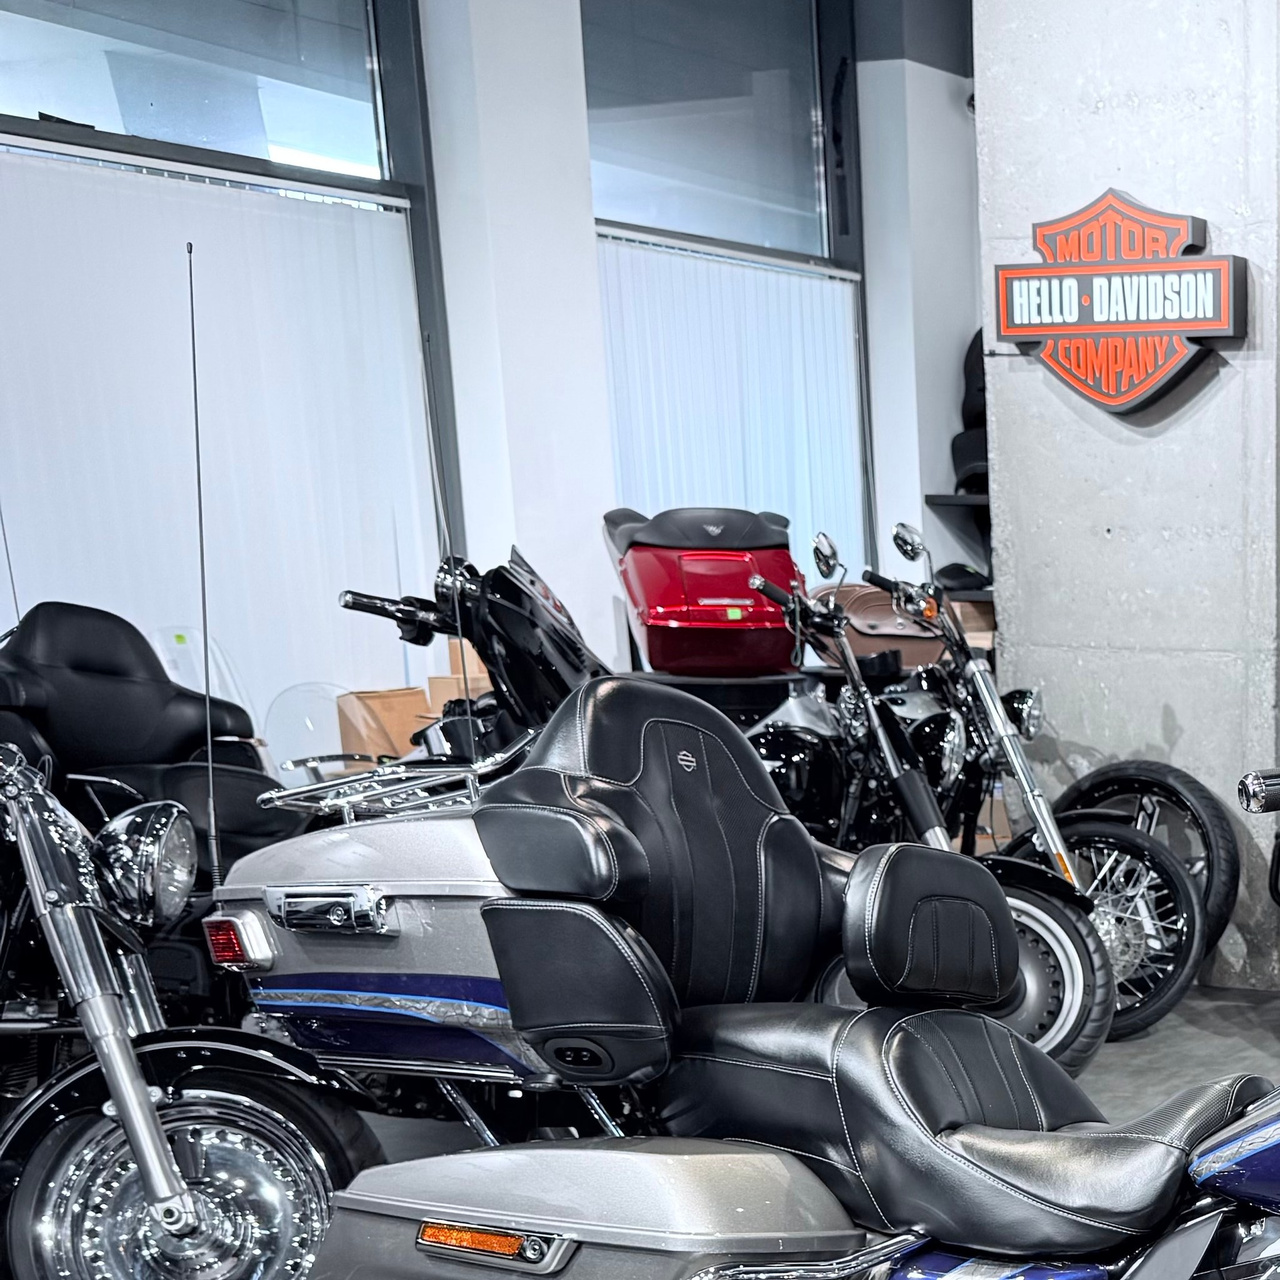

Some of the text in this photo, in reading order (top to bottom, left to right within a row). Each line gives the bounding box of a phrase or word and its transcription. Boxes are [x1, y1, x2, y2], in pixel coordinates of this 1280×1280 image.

[1056, 208, 1168, 263] MOTOR
[1012, 272, 1214, 324] HELLO DAVIDSON
[1058, 336, 1169, 394] COMPANY
